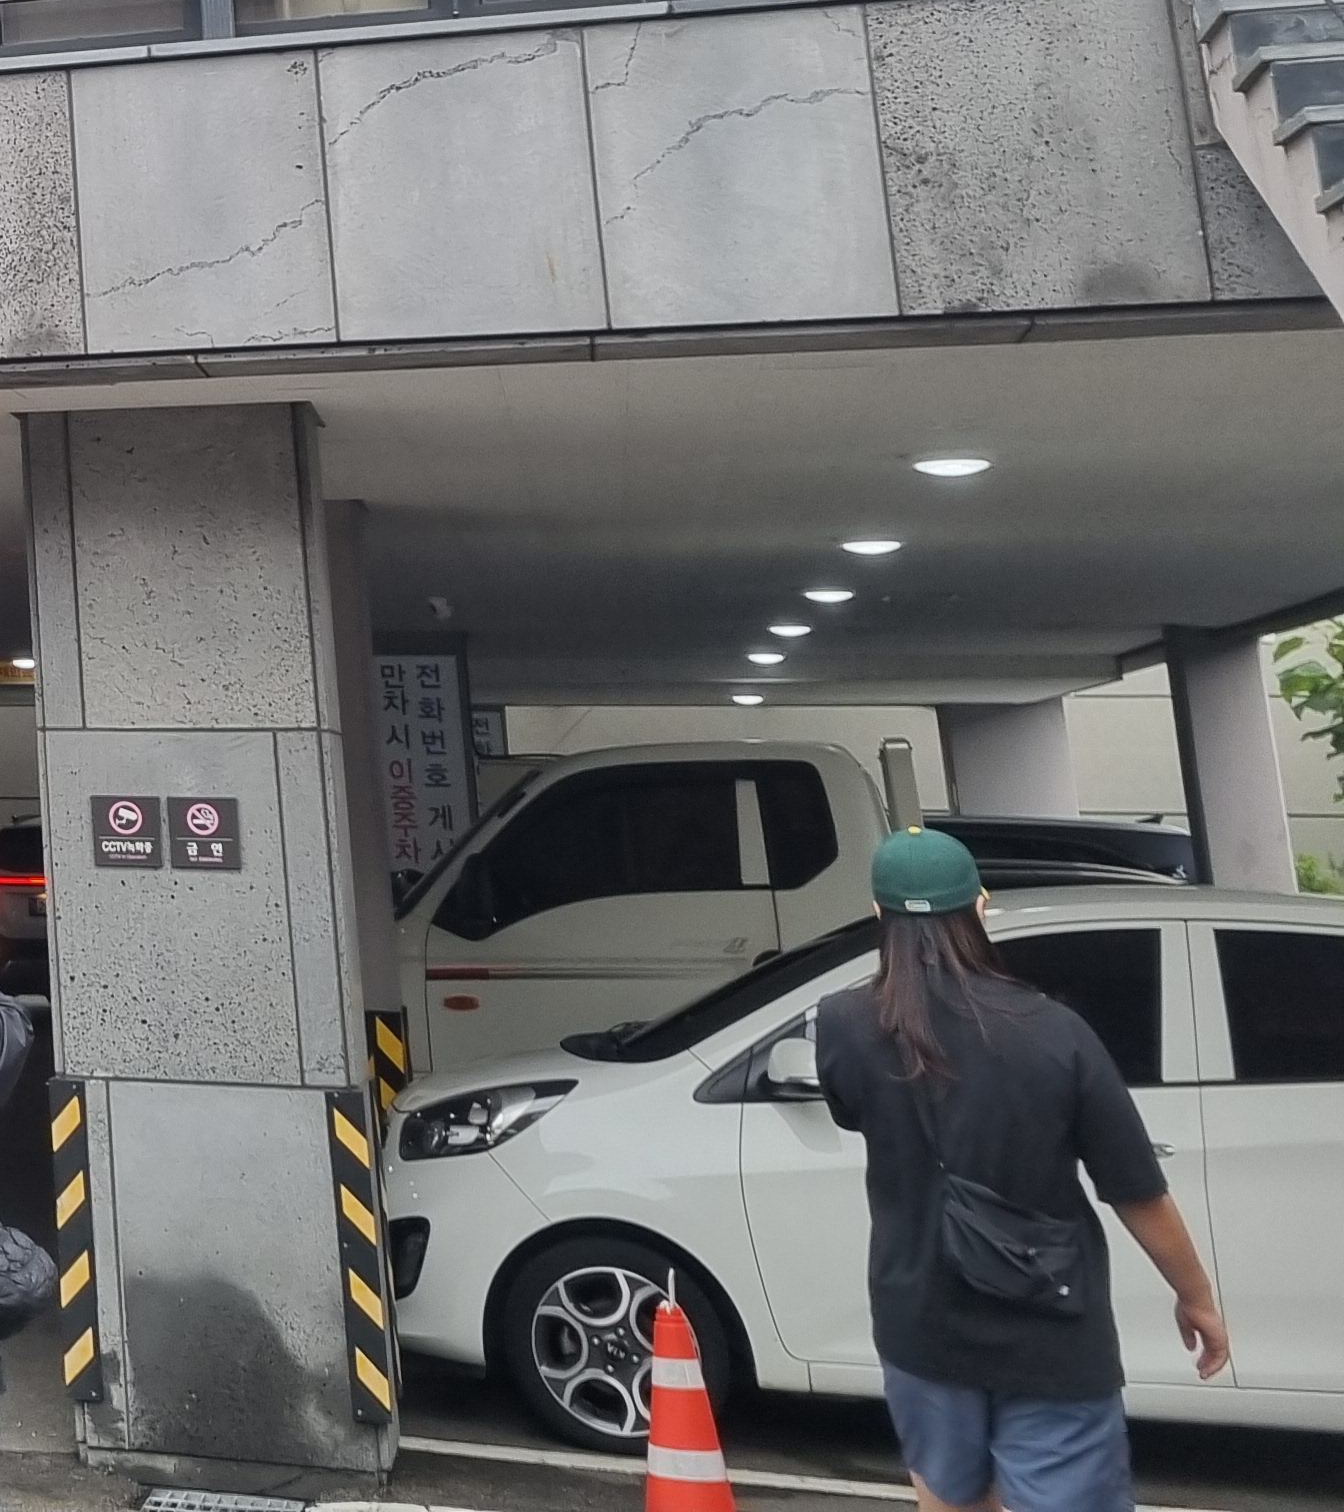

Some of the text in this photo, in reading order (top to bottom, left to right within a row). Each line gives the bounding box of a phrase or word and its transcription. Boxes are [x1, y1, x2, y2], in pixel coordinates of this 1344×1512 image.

[380, 663, 421, 863] 만차 시 이중주차
[415, 663, 452, 788] 전화번호
